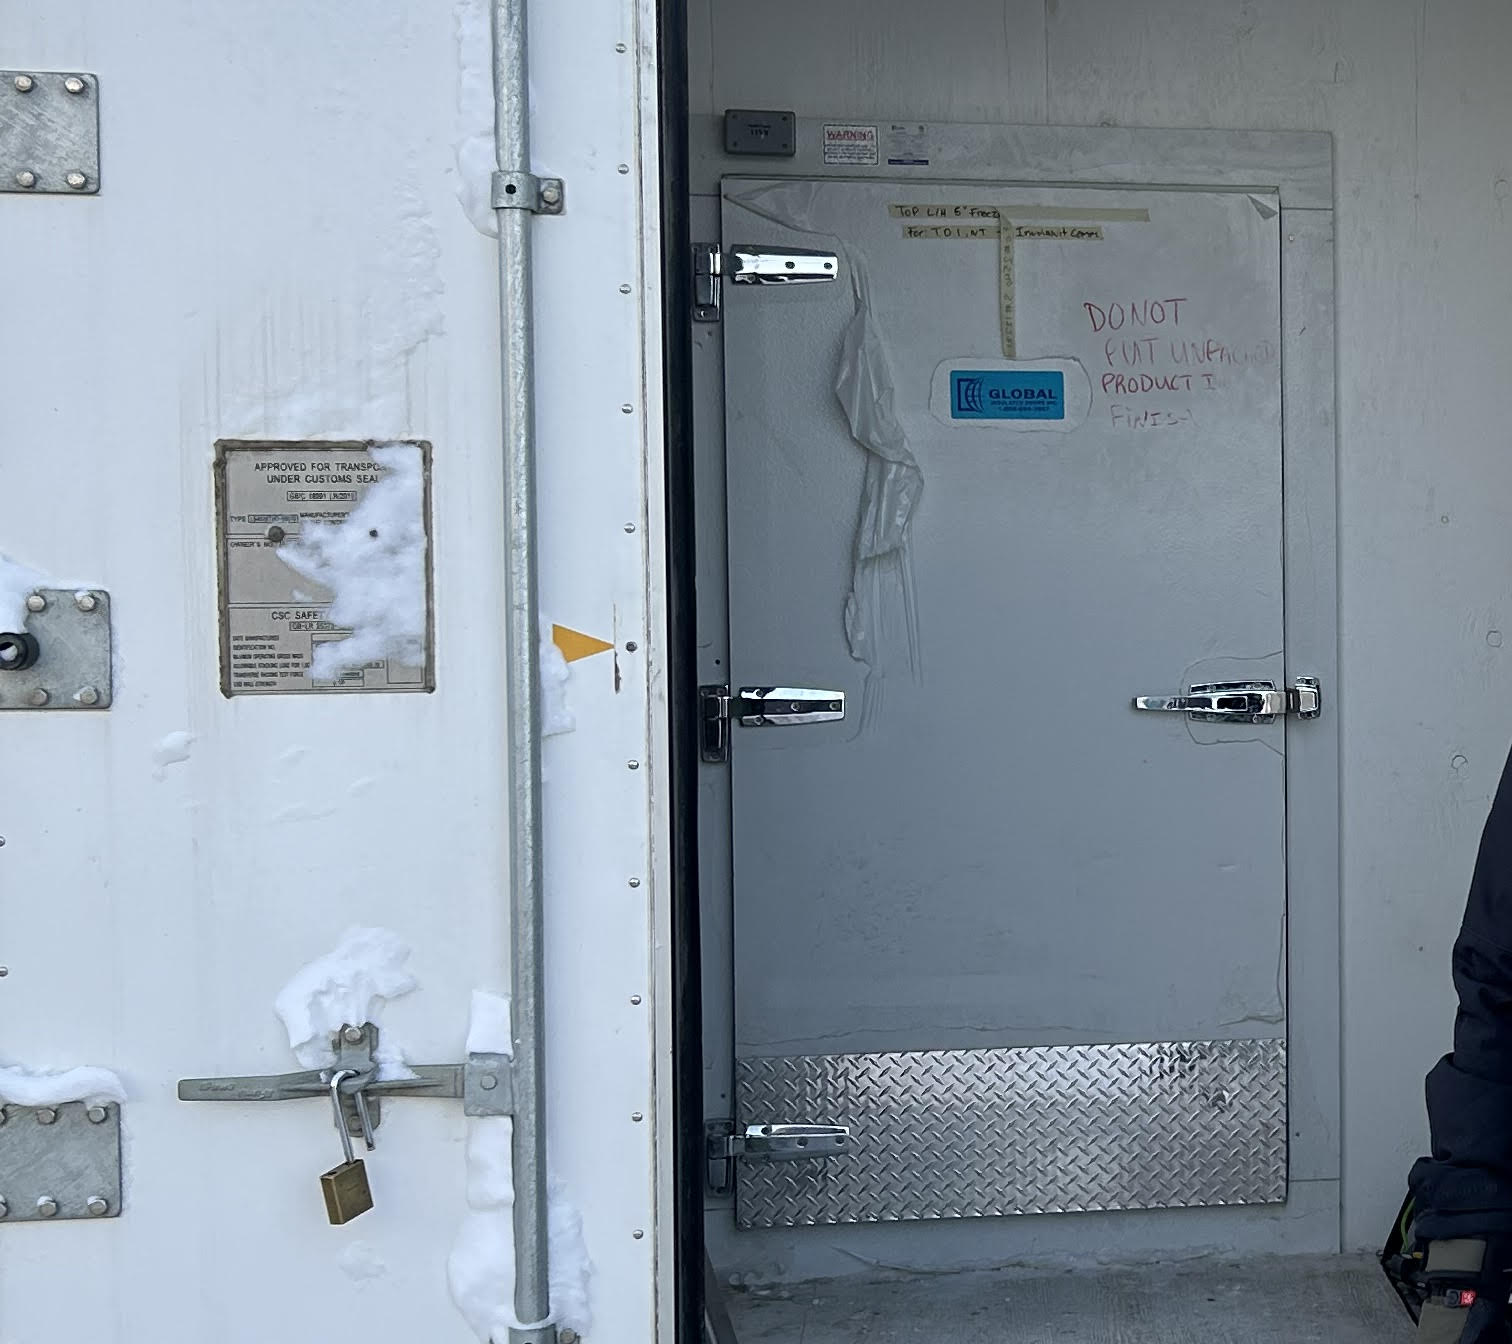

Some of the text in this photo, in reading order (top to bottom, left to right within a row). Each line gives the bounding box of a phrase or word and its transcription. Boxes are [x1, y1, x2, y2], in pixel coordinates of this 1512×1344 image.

[826, 130, 874, 141] WARNING
[1101, 372, 1193, 394] PRODUCT
[989, 388, 1057, 400] GLOBAL
[254, 462, 388, 472] APPROVED FOR TRANSPO
[267, 474, 300, 484] UNDER
[305, 474, 352, 484] CUSTOMS
[271, 611, 290, 620] CSC
